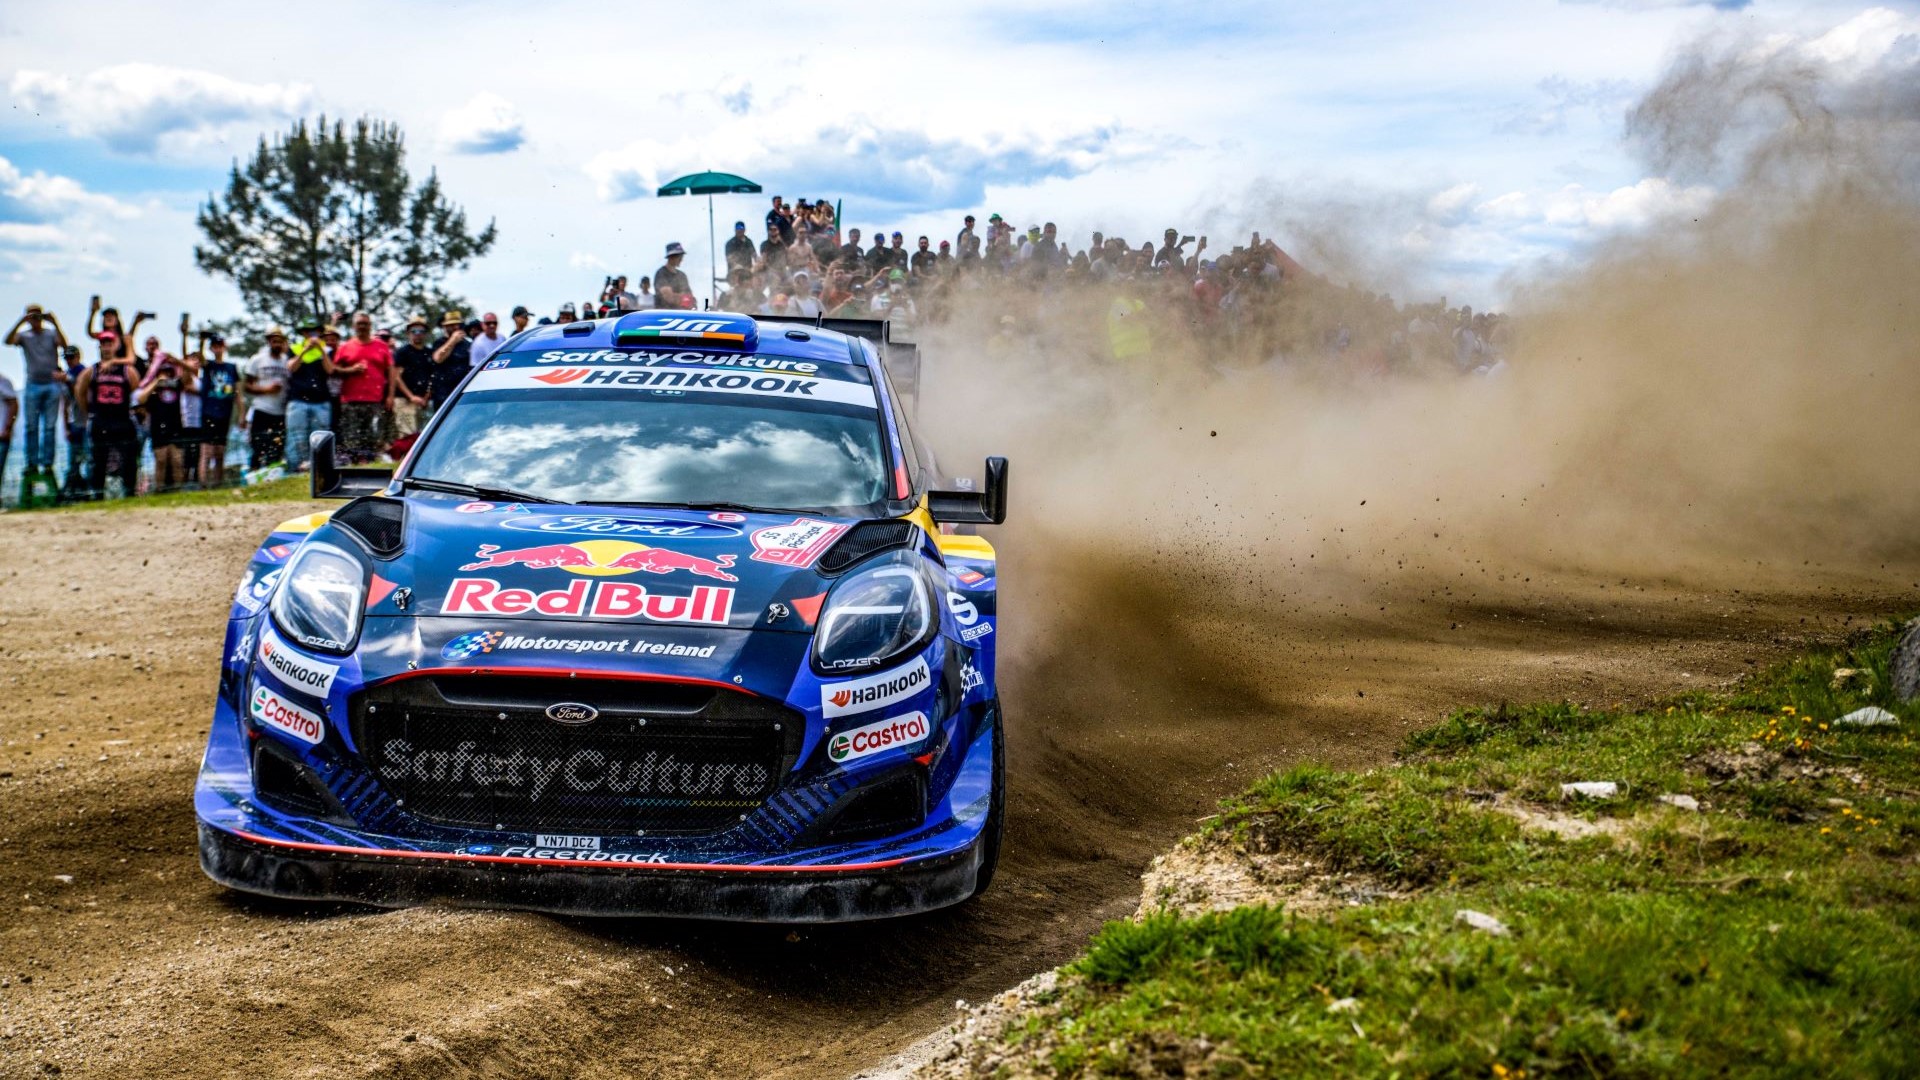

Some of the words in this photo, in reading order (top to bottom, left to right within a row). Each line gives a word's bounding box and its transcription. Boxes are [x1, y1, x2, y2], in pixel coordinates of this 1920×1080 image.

[536, 349, 819, 374] SafetyCulture
[539, 516, 702, 536] Ford
[760, 531, 782, 540] 55
[787, 526, 824, 548] Portugal
[440, 578, 594, 616] Red
[589, 581, 735, 625] Bull
[946, 591, 978, 626] S
[499, 635, 628, 653] Motorsport
[631, 639, 717, 658] Ireland
[820, 657, 881, 669] LAZER
[264, 697, 320, 740] Castrol
[556, 706, 585, 719] Ford
[852, 714, 925, 752] Castrol
[380, 738, 767, 802] SafetyCulture
[543, 836, 568, 847] YN71
[571, 837, 594, 848] DCZ
[501, 847, 669, 864] Fleetback
